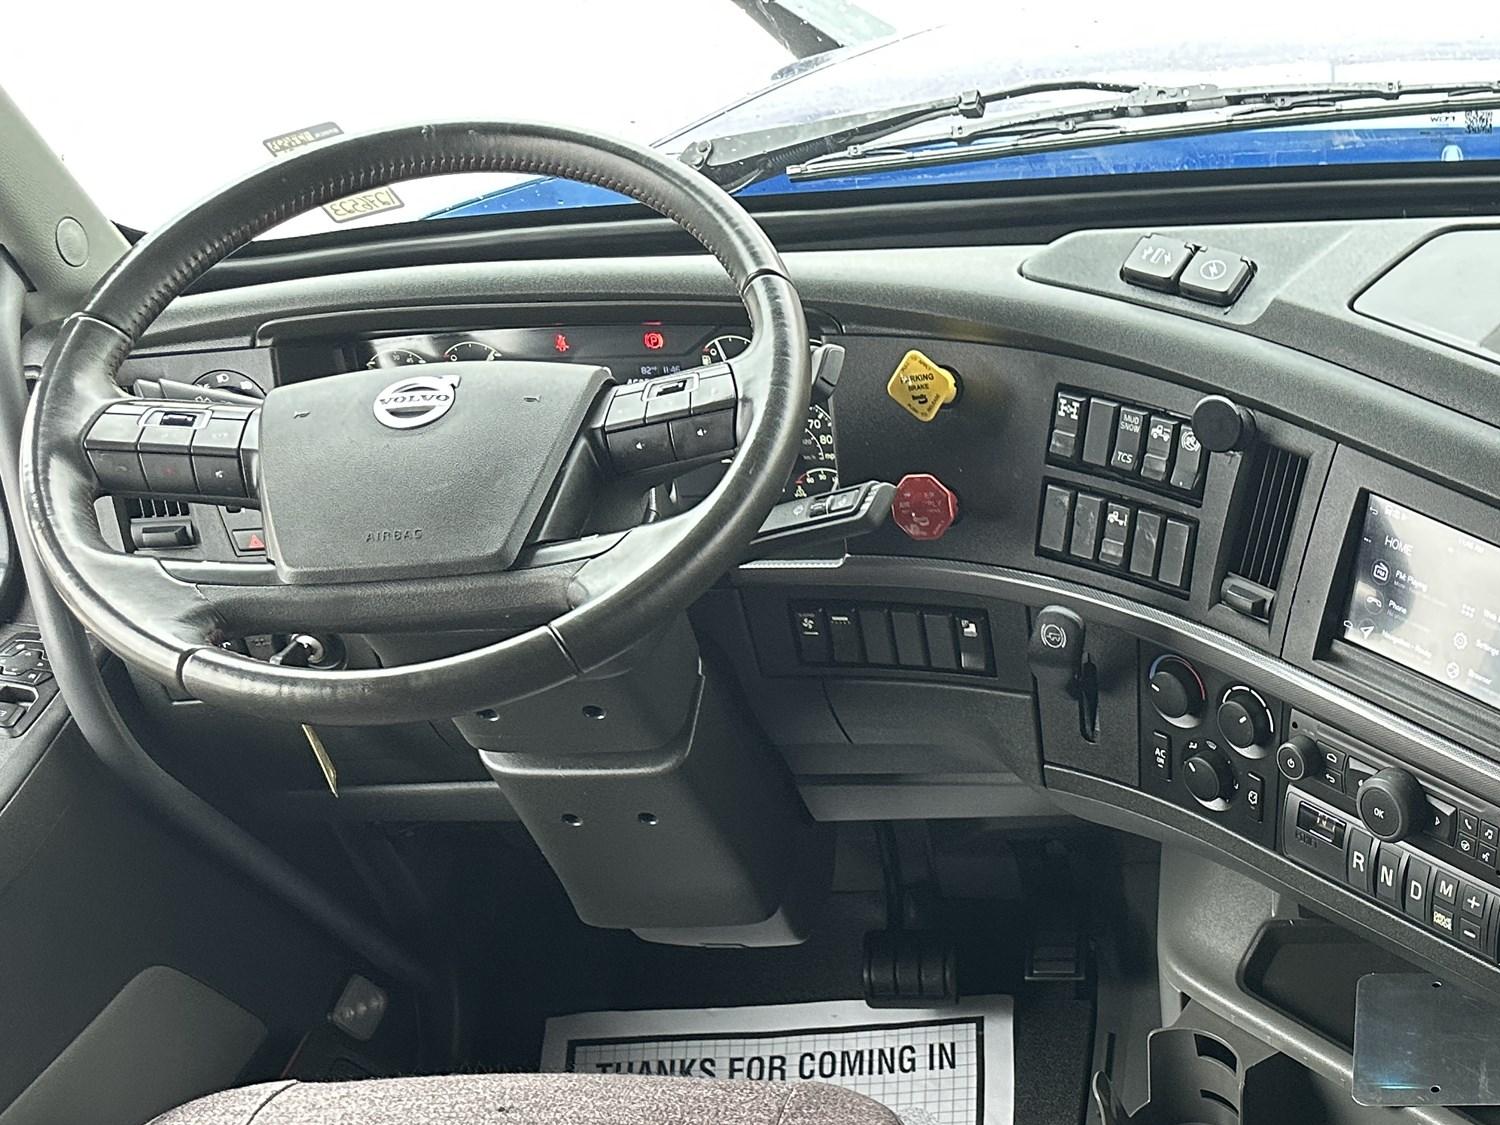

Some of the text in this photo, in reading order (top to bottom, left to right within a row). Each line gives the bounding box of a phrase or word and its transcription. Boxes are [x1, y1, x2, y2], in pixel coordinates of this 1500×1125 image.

[379, 394, 450, 405] VOLVO
[807, 419, 821, 429] 70
[1123, 414, 1140, 425] MUD
[1120, 422, 1140, 433] SNOW
[820, 434, 833, 445] 80
[1117, 451, 1134, 463] TCS
[365, 529, 423, 542] AIRBAG
[1384, 535, 1414, 557] HOME
[1154, 747, 1166, 759] AC
[1373, 807, 1385, 819] OK
[1352, 851, 1365, 872] R
[1381, 866, 1393, 887] N
[1410, 883, 1422, 900] D
[1439, 880, 1453, 898] M
[729, 1055, 787, 1081] FOR
[799, 1045, 917, 1080] COMING
[928, 1041, 957, 1071] IN
